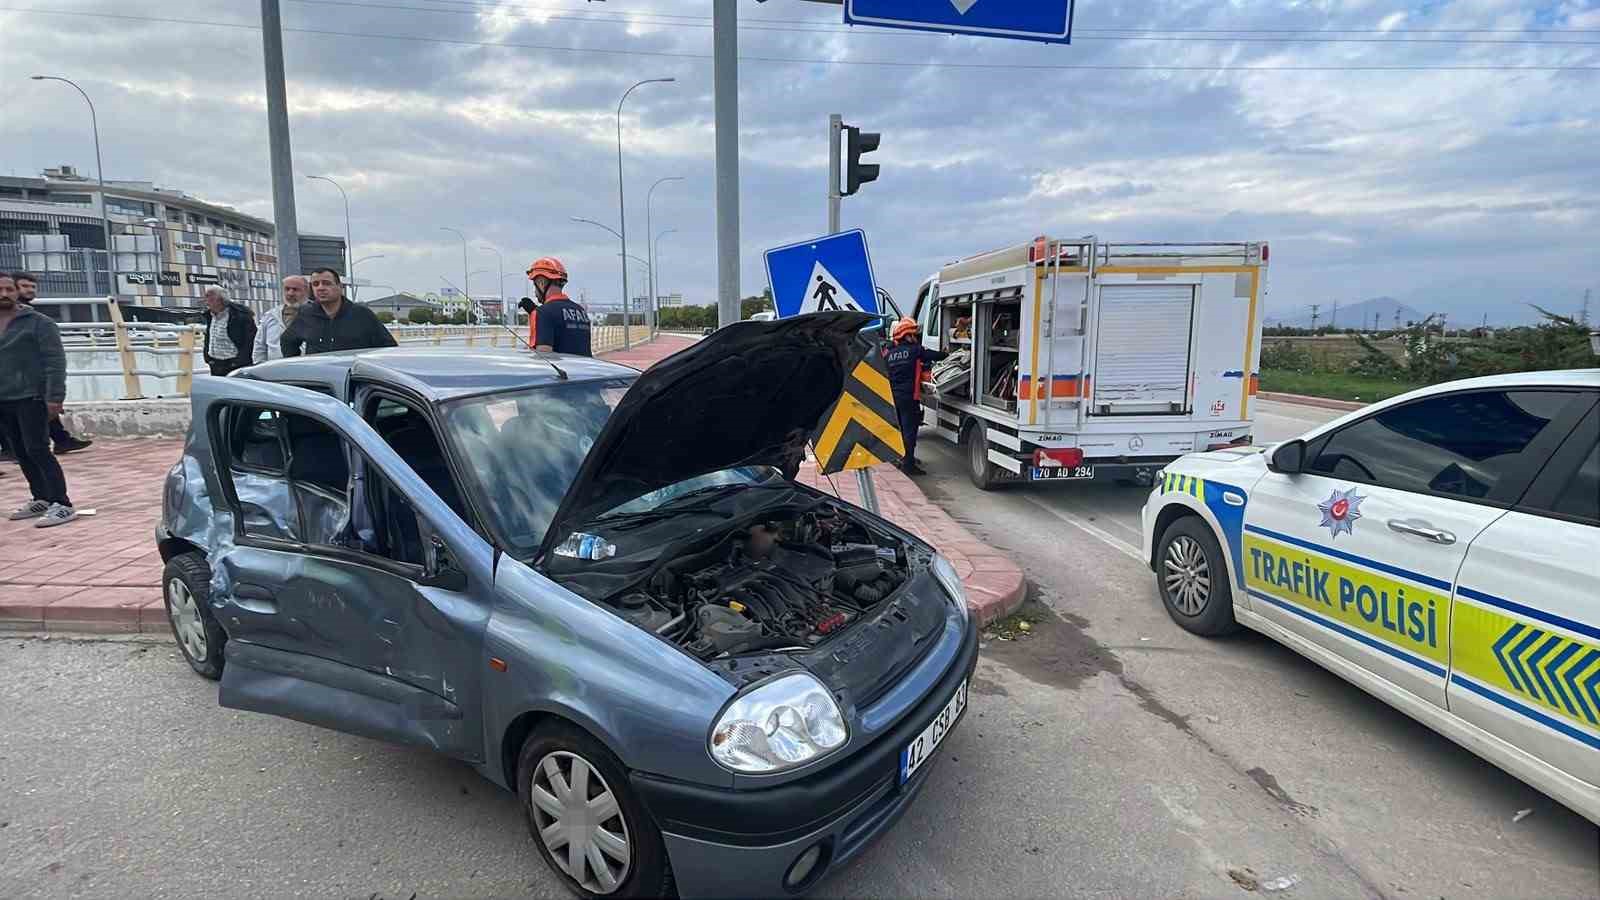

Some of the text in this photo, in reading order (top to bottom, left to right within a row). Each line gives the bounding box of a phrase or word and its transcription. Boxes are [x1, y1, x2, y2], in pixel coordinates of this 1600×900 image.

[888, 350, 909, 361] AFAD
[1039, 467, 1092, 478] 70 AD 294
[1250, 547, 1438, 649] TRAFİK POLİSİ
[908, 736, 924, 770] 42
